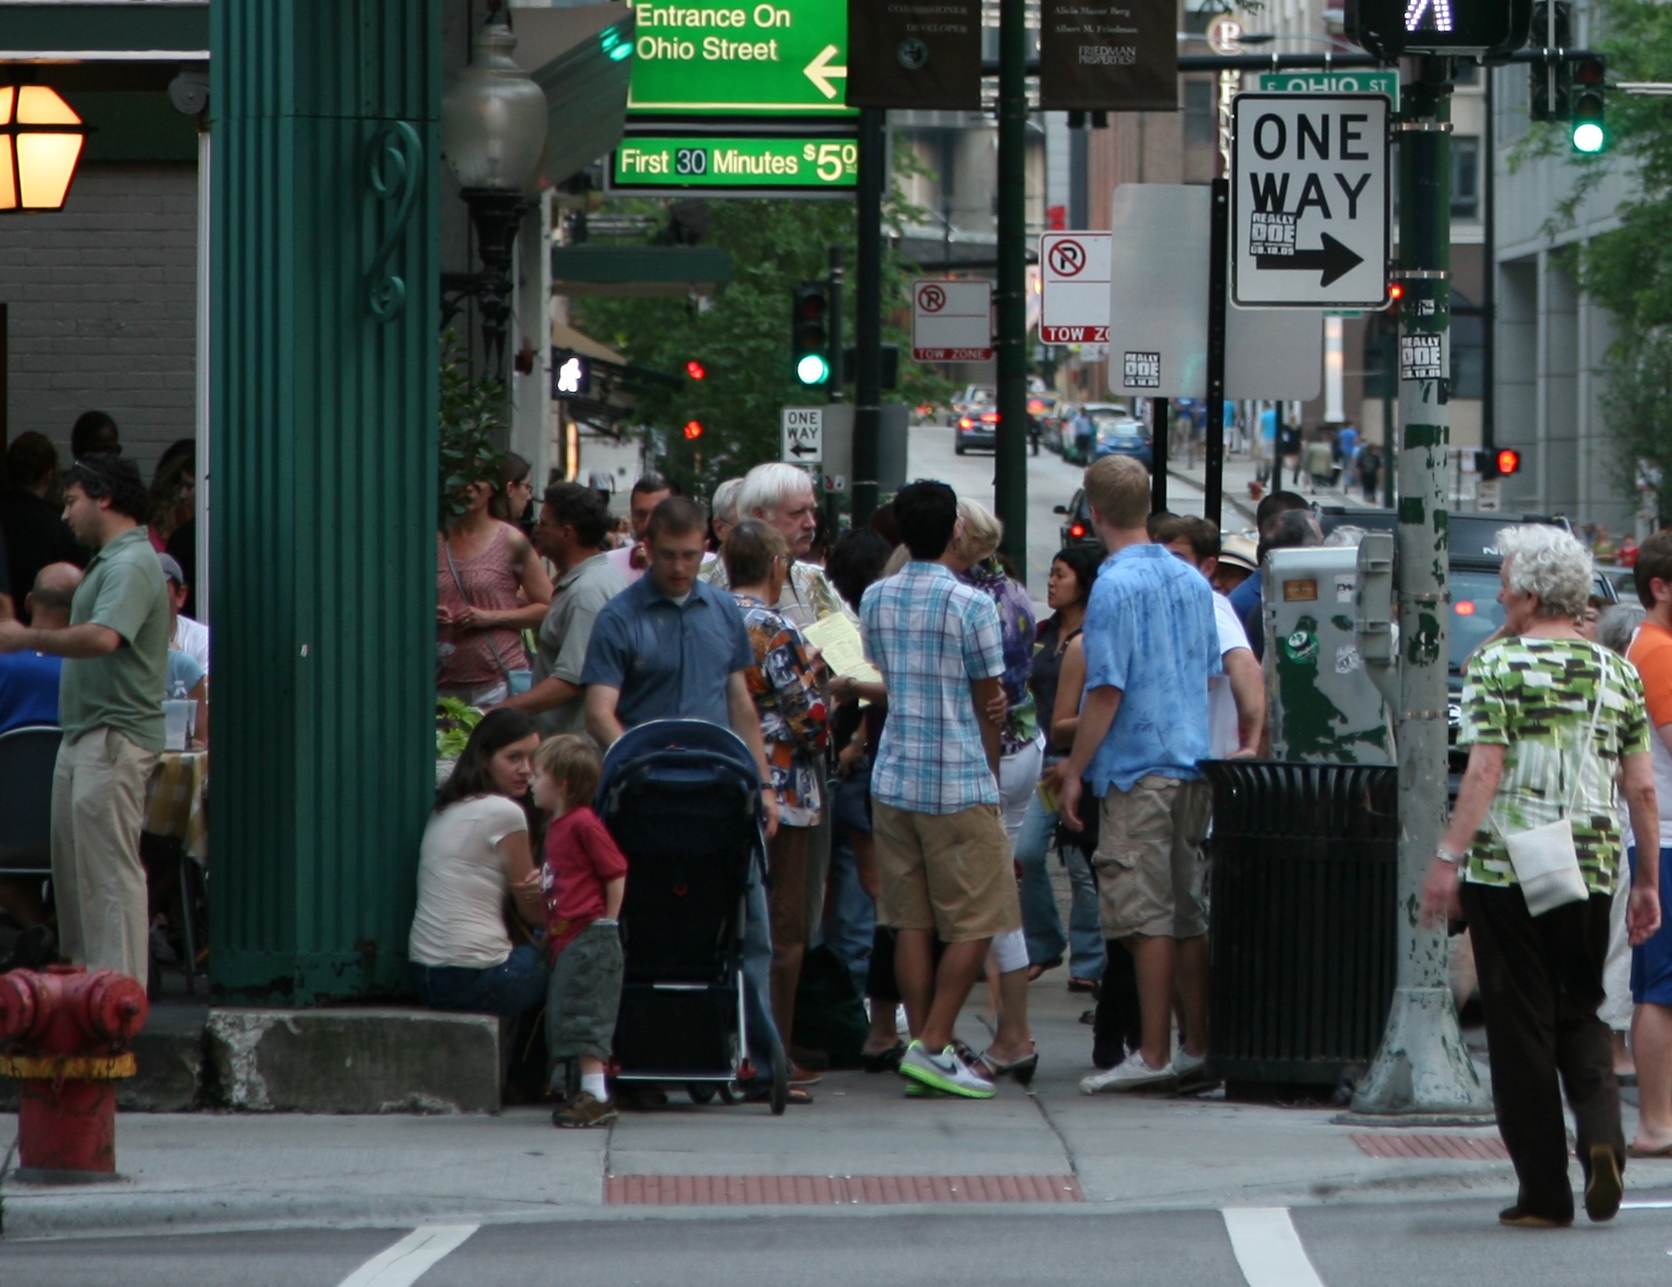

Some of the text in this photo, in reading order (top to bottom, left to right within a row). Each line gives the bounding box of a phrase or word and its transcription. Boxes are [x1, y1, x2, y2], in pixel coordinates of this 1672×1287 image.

[636, 4, 791, 28] Entrance On
[637, 36, 780, 61] Ohio Street
[1078, 45, 1137, 57] FRIEDMAN
[1287, 77, 1359, 92] OHIO
[1369, 79, 1388, 92] ST
[1253, 113, 1369, 161] ONE
[621, 149, 669, 174] First
[675, 148, 706, 175] 30
[713, 149, 799, 175] Minutes
[1250, 172, 1373, 220] WAY
[1252, 212, 1296, 225] REALLY
[1251, 223, 1296, 243] DOE
[1047, 326, 1085, 342] TOW
[1402, 336, 1441, 347] REALLY
[918, 349, 985, 361] TOW ZONE
[1402, 346, 1441, 366] DOE
[787, 411, 818, 425] ONE
[787, 426, 819, 440] WAY
